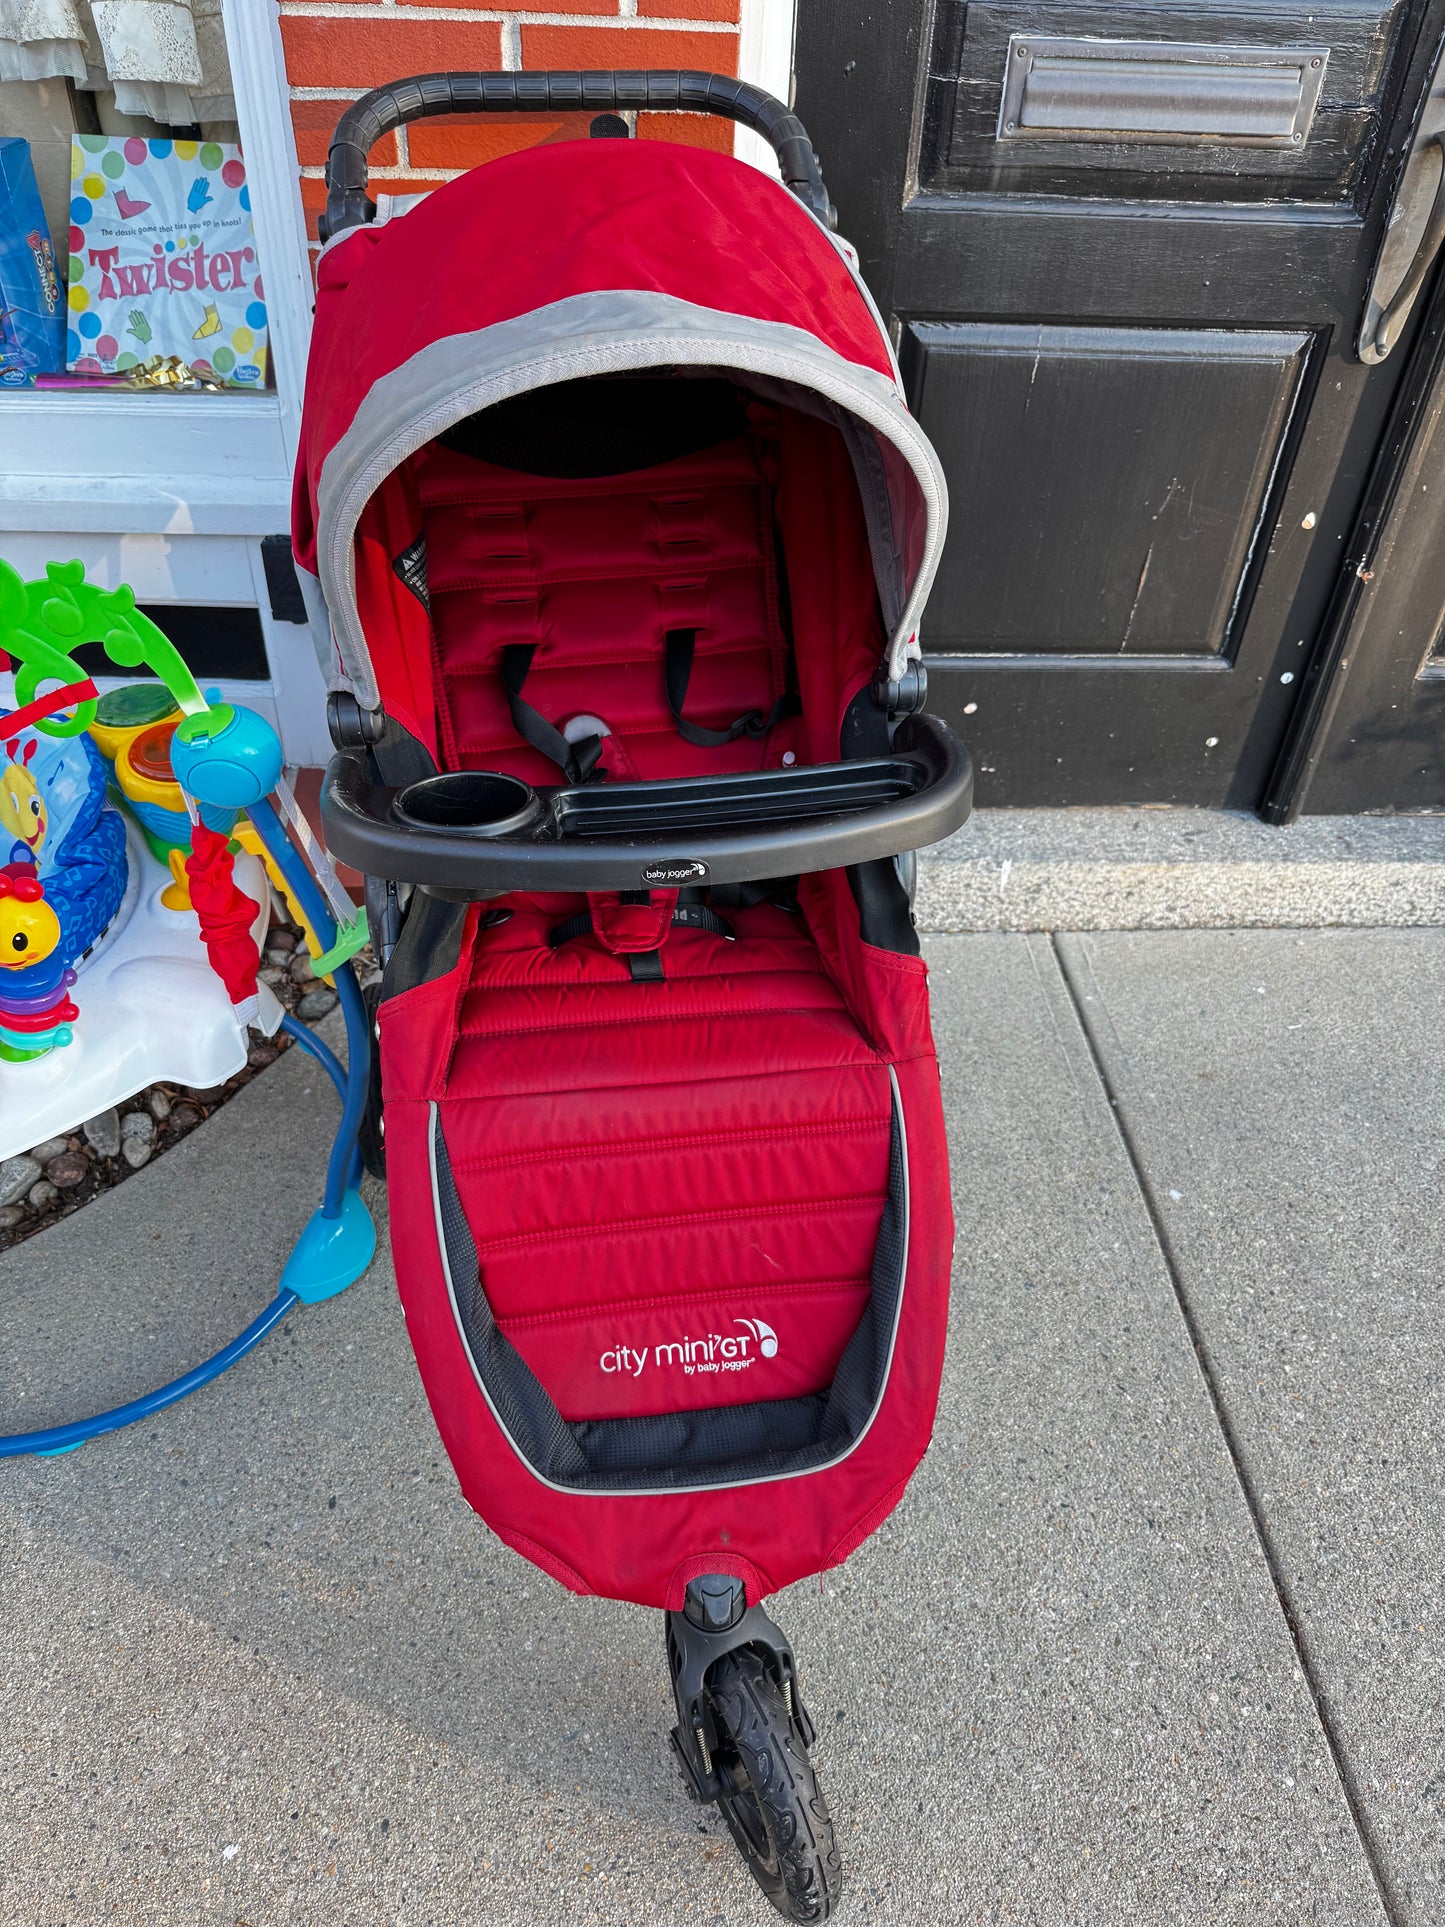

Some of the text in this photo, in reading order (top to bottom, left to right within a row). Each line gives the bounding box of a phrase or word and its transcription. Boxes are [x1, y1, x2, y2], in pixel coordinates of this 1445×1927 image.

[101, 216, 242, 236] The classic game that ties you up in knots!
[33, 248, 56, 316] CONNECT
[88, 241, 255, 301] Twister
[646, 869, 693, 880] baby jogger
[600, 1344, 648, 1377] city
[684, 1364, 695, 1375] by
[697, 1362, 720, 1374] baby
